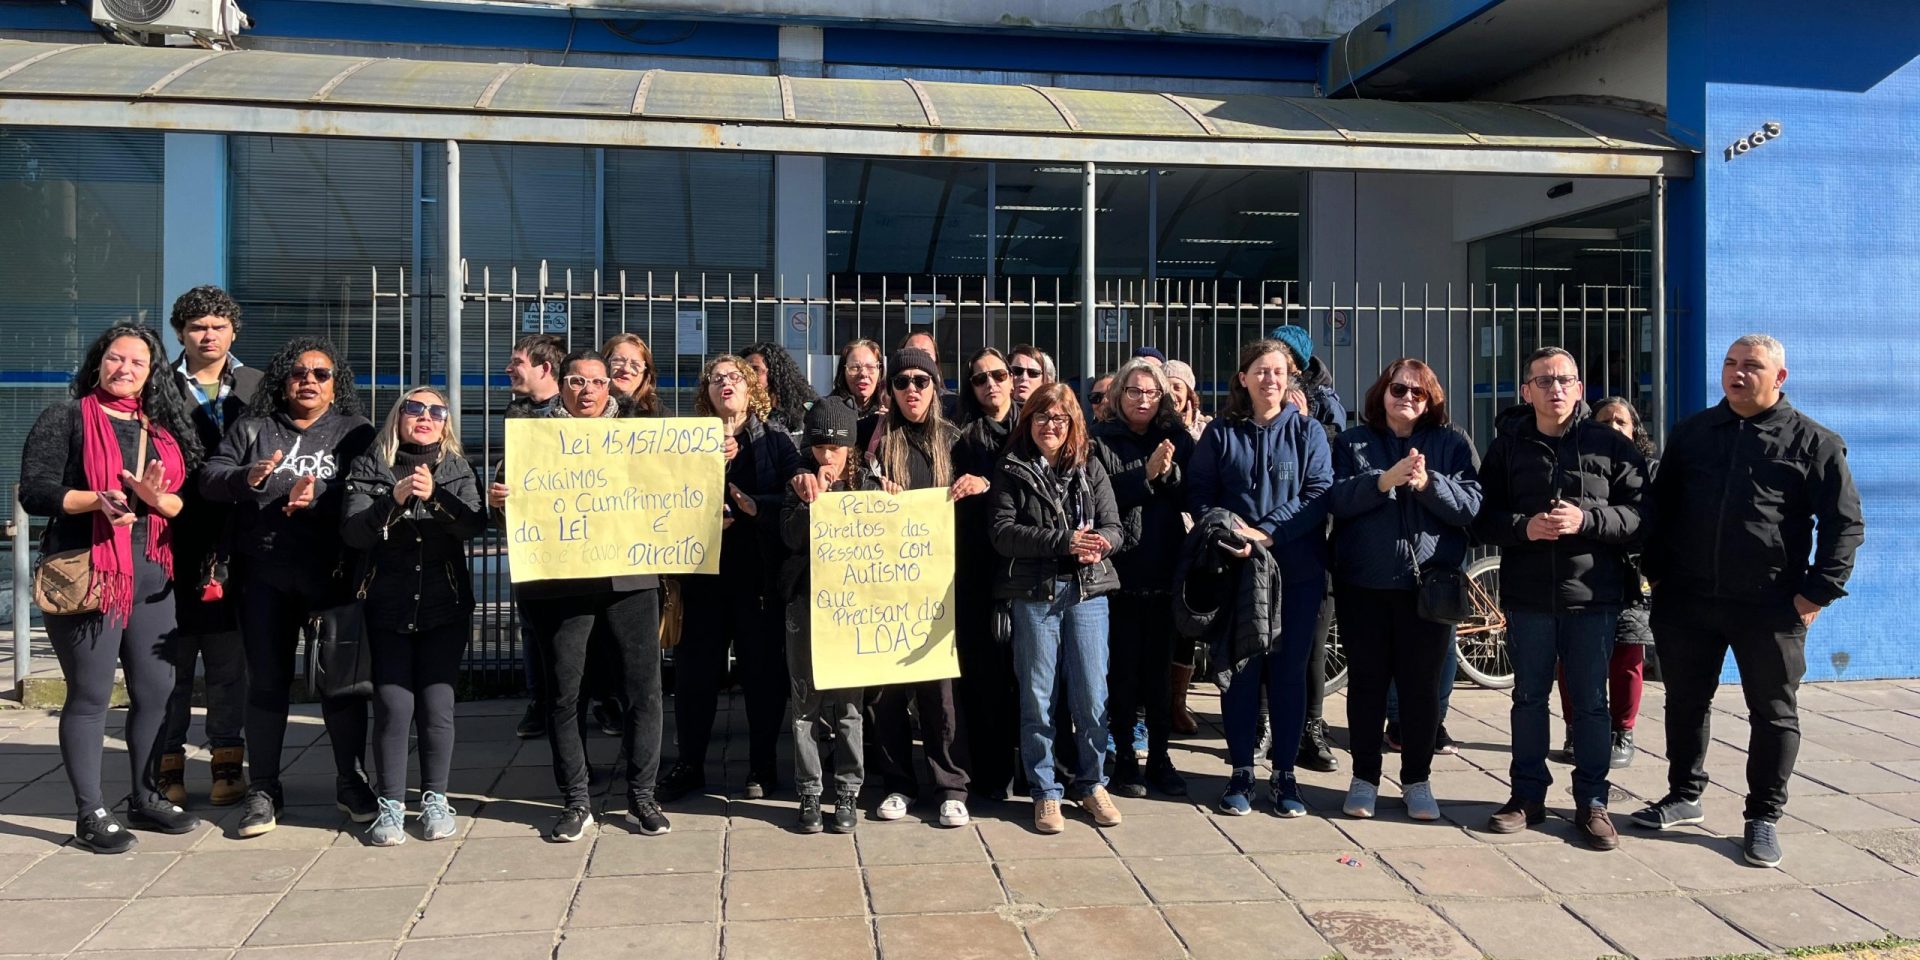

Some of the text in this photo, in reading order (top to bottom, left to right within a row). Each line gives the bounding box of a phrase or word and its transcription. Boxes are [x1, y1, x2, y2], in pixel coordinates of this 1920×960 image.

[559, 430, 590, 455] Lei
[514, 520, 545, 543] da
[814, 518, 930, 540] Direitos das
[627, 535, 705, 567] Direito
[856, 621, 929, 655] LOAS
